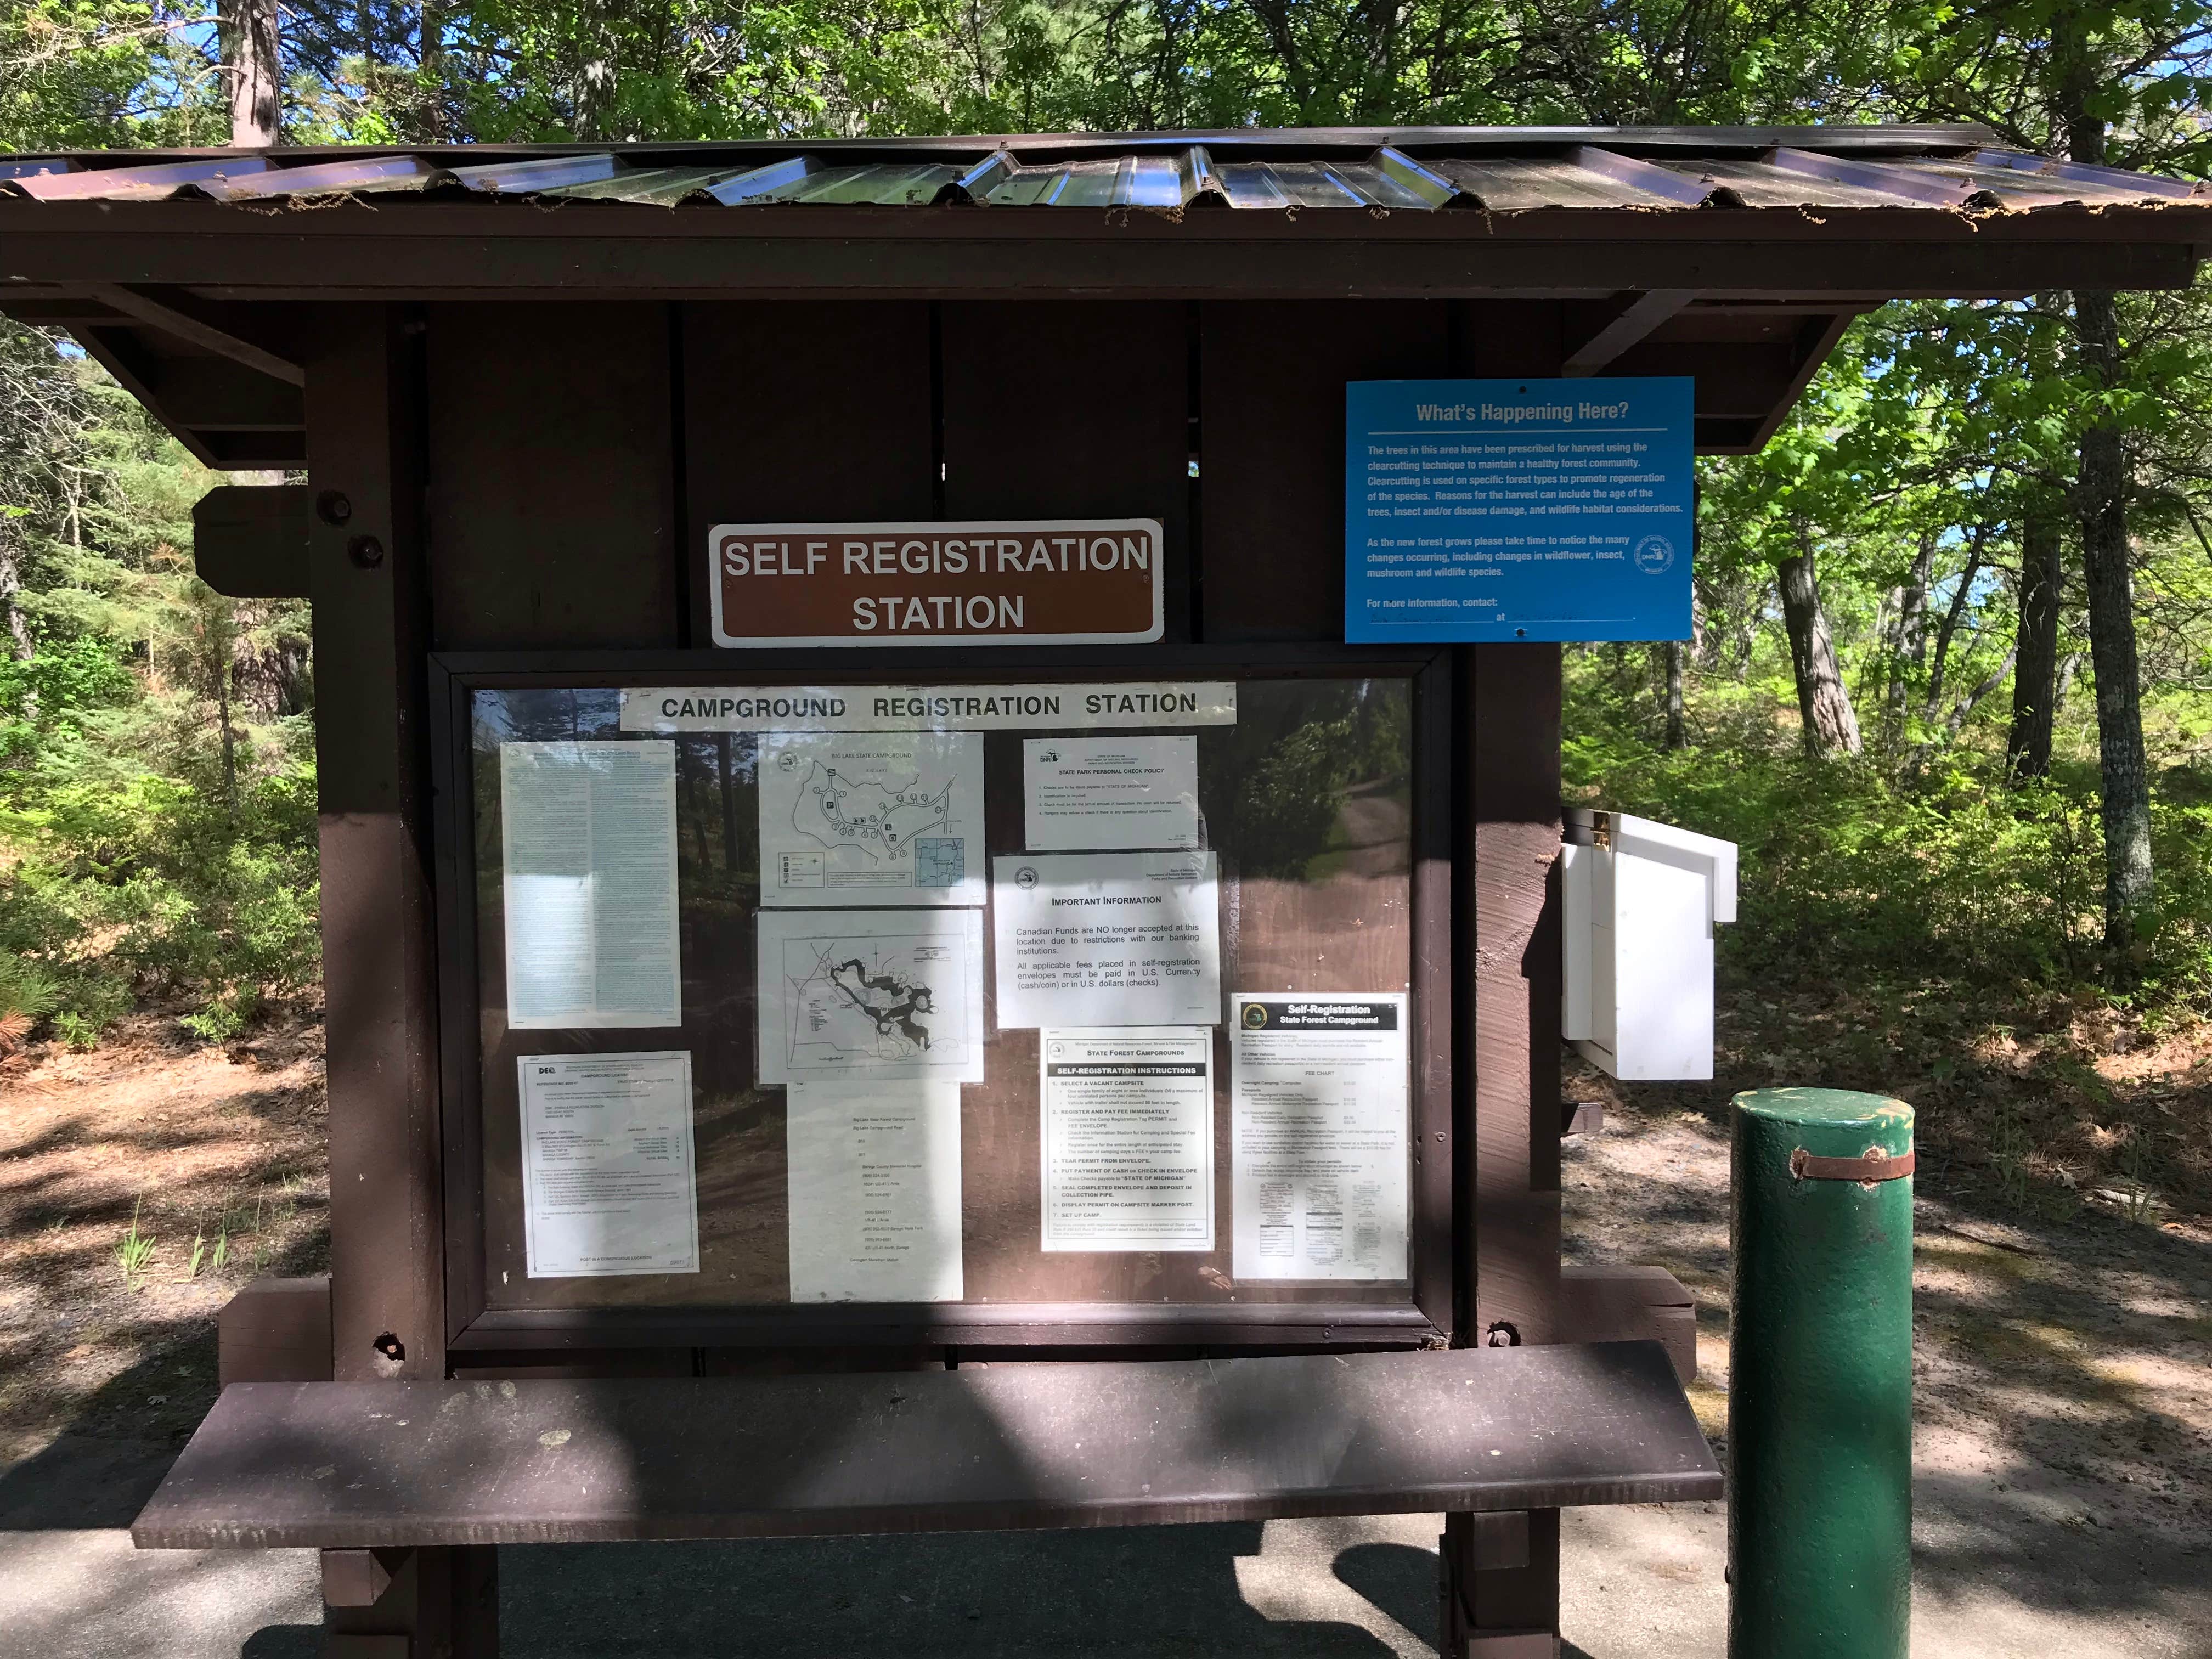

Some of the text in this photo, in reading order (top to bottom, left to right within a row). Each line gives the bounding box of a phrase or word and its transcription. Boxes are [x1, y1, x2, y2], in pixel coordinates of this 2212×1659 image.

[1416, 402, 1629, 424] What's Happening Here?
[1368, 446, 1384, 455] The
[1386, 446, 1408, 455] trees
[1410, 445, 1419, 454] in
[1421, 445, 1437, 454] this
[1461, 444, 1482, 454] have
[1484, 444, 1506, 453] been
[1508, 444, 1554, 455] prescribed
[1556, 443, 1570, 453] for
[1571, 443, 1604, 452] harvest
[1606, 443, 1630, 454] using
[1633, 443, 1647, 452] the
[1367, 461, 1420, 472] clearcutting
[1421, 460, 1465, 471] technique
[1467, 461, 1476, 469] to
[1478, 460, 1516, 469] maintain
[1526, 459, 1559, 470] healthy
[1561, 459, 1587, 468] forest
[1367, 476, 1420, 487] Clearcutting
[1423, 476, 1430, 485] is
[1432, 476, 1453, 485] used
[1469, 475, 1504, 486] specific
[1505, 475, 1531, 483] forest
[1533, 475, 1557, 485] types
[1559, 475, 1568, 483] to
[1571, 475, 1607, 484] promote
[1609, 473, 1665, 484] regeneration
[1367, 492, 1376, 501] of
[1378, 492, 1392, 501] the
[1435, 491, 1472, 500] Reasons
[1474, 490, 1487, 500] for
[1488, 490, 1503, 499] the
[1505, 490, 1538, 499] harvest
[1558, 489, 1590, 498] include
[1593, 489, 1607, 498] the
[1609, 490, 1626, 499] age
[1627, 488, 1637, 498] of
[1638, 489, 1653, 497] the
[1394, 507, 1420, 516] insect
[1423, 507, 1452, 516] and/or
[1454, 506, 1487, 515] disease
[1529, 505, 1545, 514] and
[1548, 505, 1581, 514] wildlife
[1582, 504, 1613, 514] habitat
[1367, 538, 1378, 547] As
[1380, 538, 1395, 546] the
[1417, 537, 1443, 546] forest
[1444, 539, 1472, 548] grows
[1474, 537, 1503, 547] please
[1505, 537, 1525, 545] take
[1526, 536, 1547, 545] time
[1548, 536, 1557, 545] to
[1559, 535, 1587, 544] notice
[1589, 535, 1603, 544] the
[1605, 537, 1629, 545] many
[726, 537, 1147, 575] SELF REGISTRATION
[1367, 553, 1404, 564] changes
[1452, 552, 1493, 563] including
[1494, 552, 1532, 562] changes
[1533, 551, 1543, 560] in
[1367, 568, 1413, 577] mushroom
[1415, 568, 1432, 577] and
[1434, 567, 1466, 577] wildlife
[1367, 599, 1381, 608] For
[853, 595, 1023, 630] STATION
[1496, 613, 1505, 622] at
[662, 693, 1195, 718] CAMPGROUND REGISTRATION STATION
[1052, 896, 1161, 906] IMPORTANT INFORMATION
[1111, 926, 1136, 934] longer
[1138, 924, 1173, 934] accepted
[1169, 933, 1199, 943] banking
[1032, 962, 1070, 970] applicable
[1098, 960, 1124, 969] placed
[1141, 958, 1200, 968] self-registration
[1017, 972, 1056, 981] envelopes
[1105, 970, 1121, 979] paid
[1165, 968, 1200, 977] Currency
[1018, 979, 1059, 990] (cash/coin)
[1126, 979, 1161, 988] (checks).
[1288, 1004, 1370, 1016] Self-Registration
[1328, 1014, 1378, 1025] Campground
